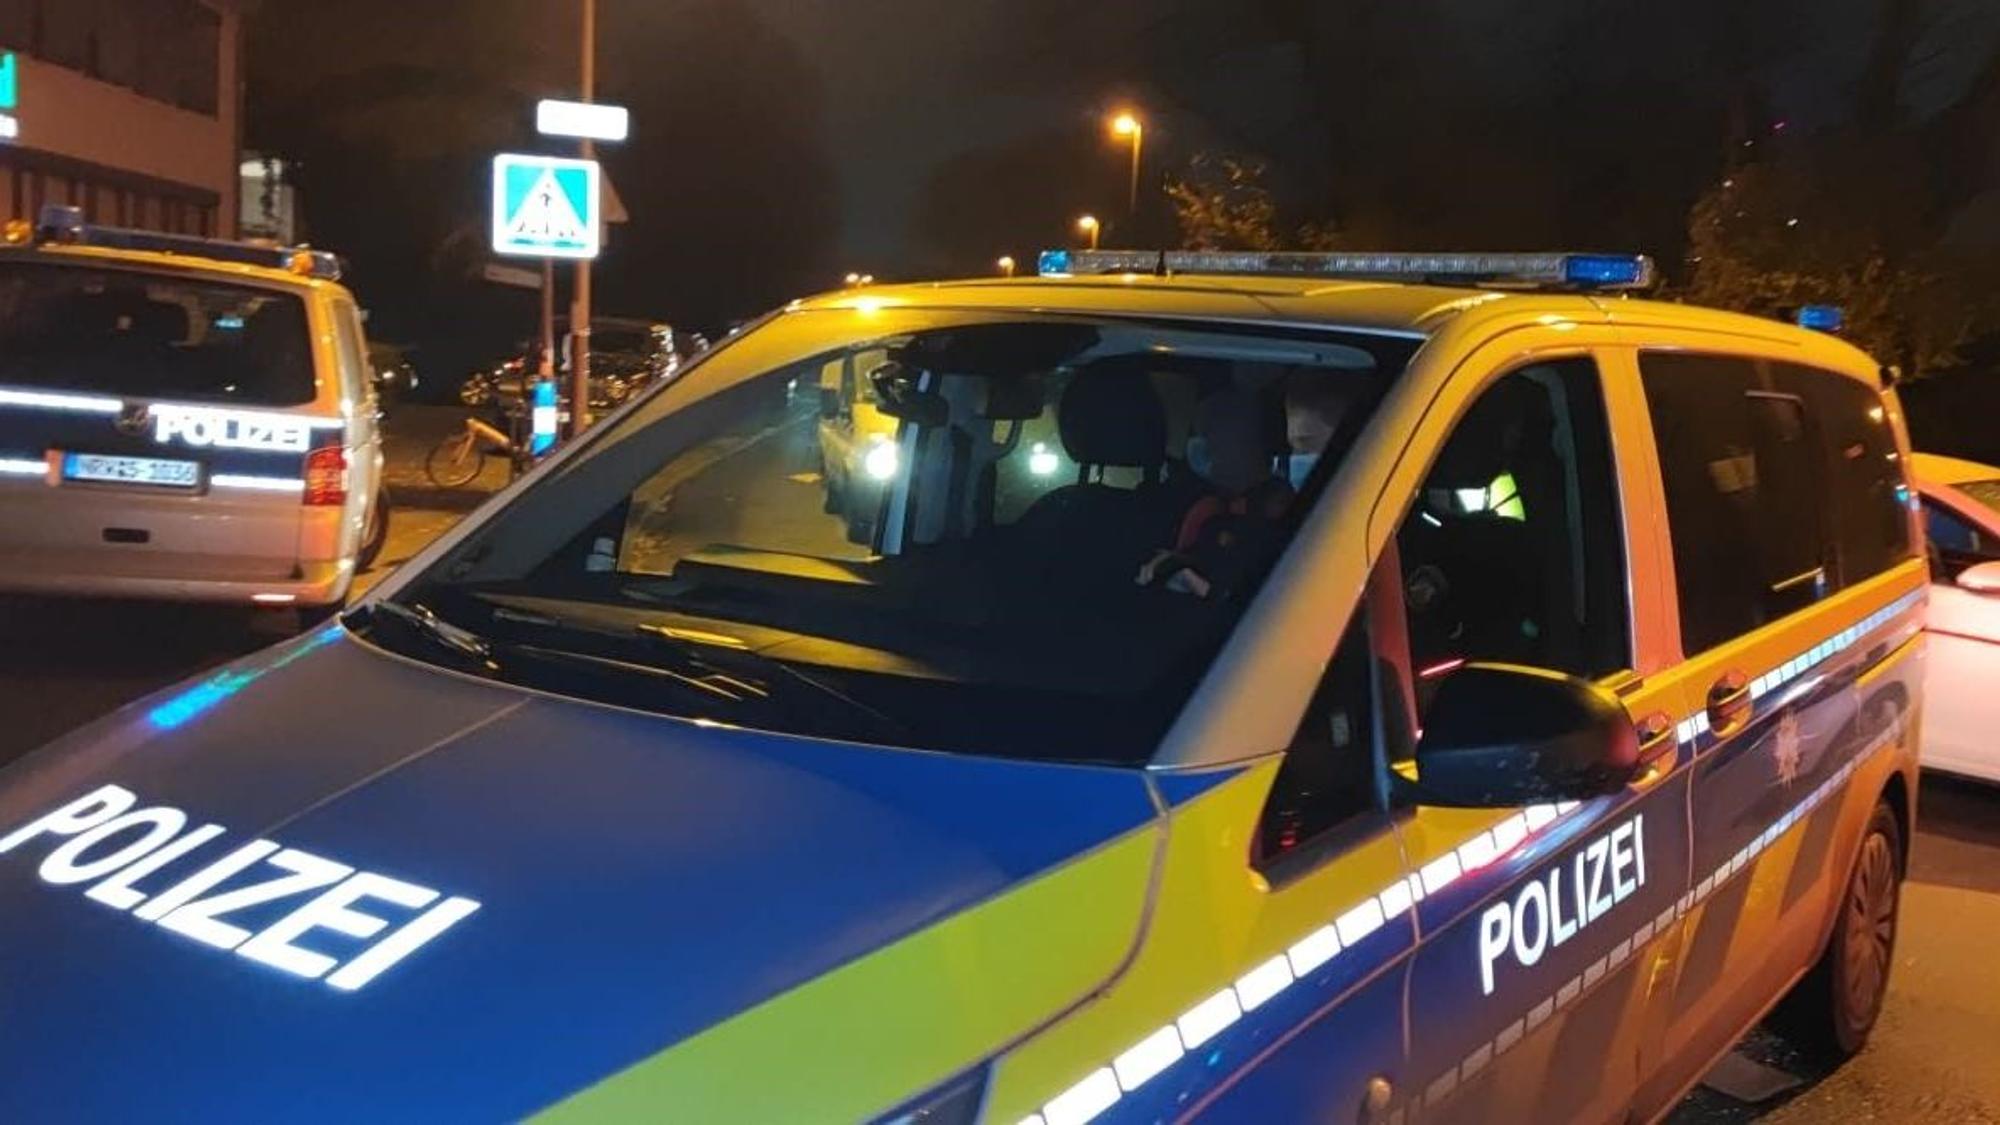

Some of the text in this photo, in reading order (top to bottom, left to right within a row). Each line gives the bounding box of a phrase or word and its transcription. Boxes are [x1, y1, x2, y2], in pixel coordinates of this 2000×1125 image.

[155, 410, 310, 451] POLIZEI
[0, 784, 482, 991] POLIZEI
[1479, 812, 1646, 997] POLIZEI
